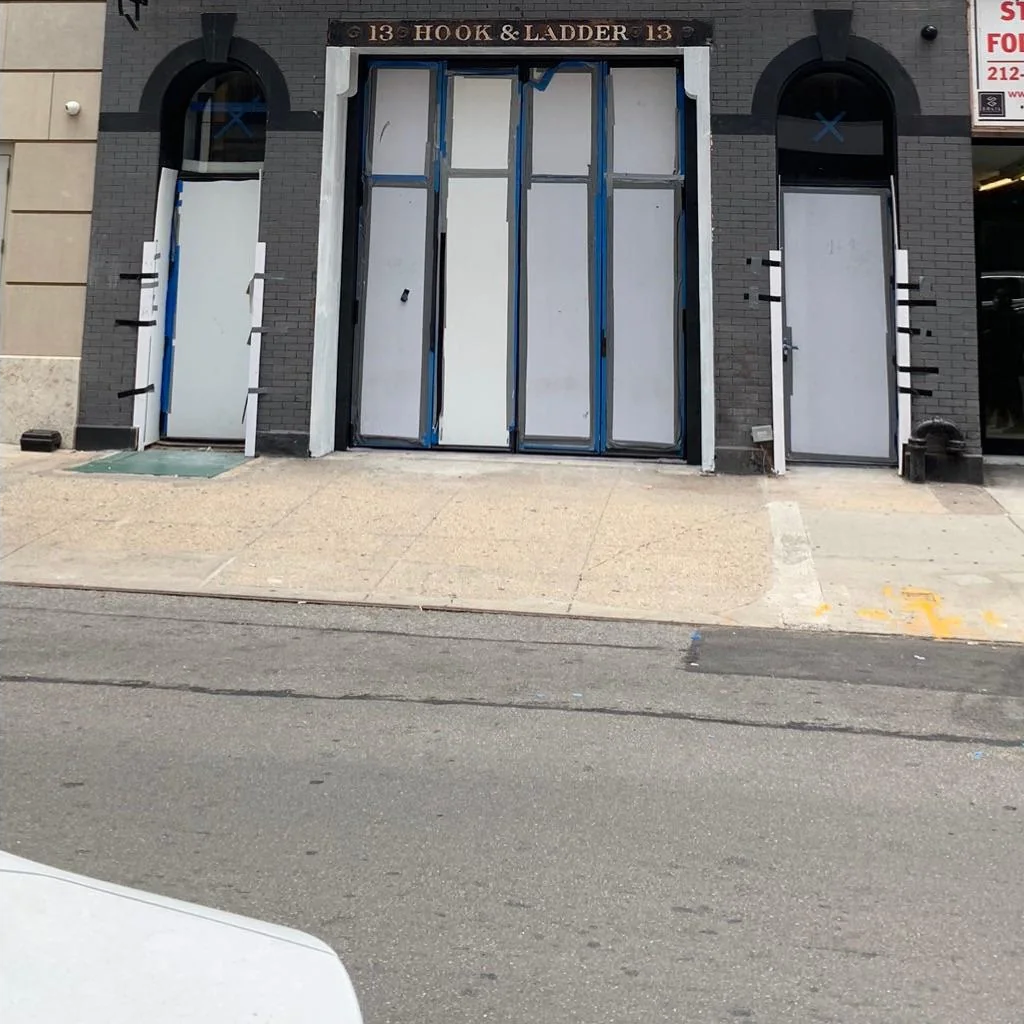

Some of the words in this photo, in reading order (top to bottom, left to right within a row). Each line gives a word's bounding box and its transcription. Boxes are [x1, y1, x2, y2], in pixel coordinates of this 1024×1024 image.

[367, 23, 394, 42] 13
[413, 23, 493, 42] HOOK
[500, 24, 520, 42] &
[523, 23, 629, 42] LADDER
[645, 23, 673, 41] 13
